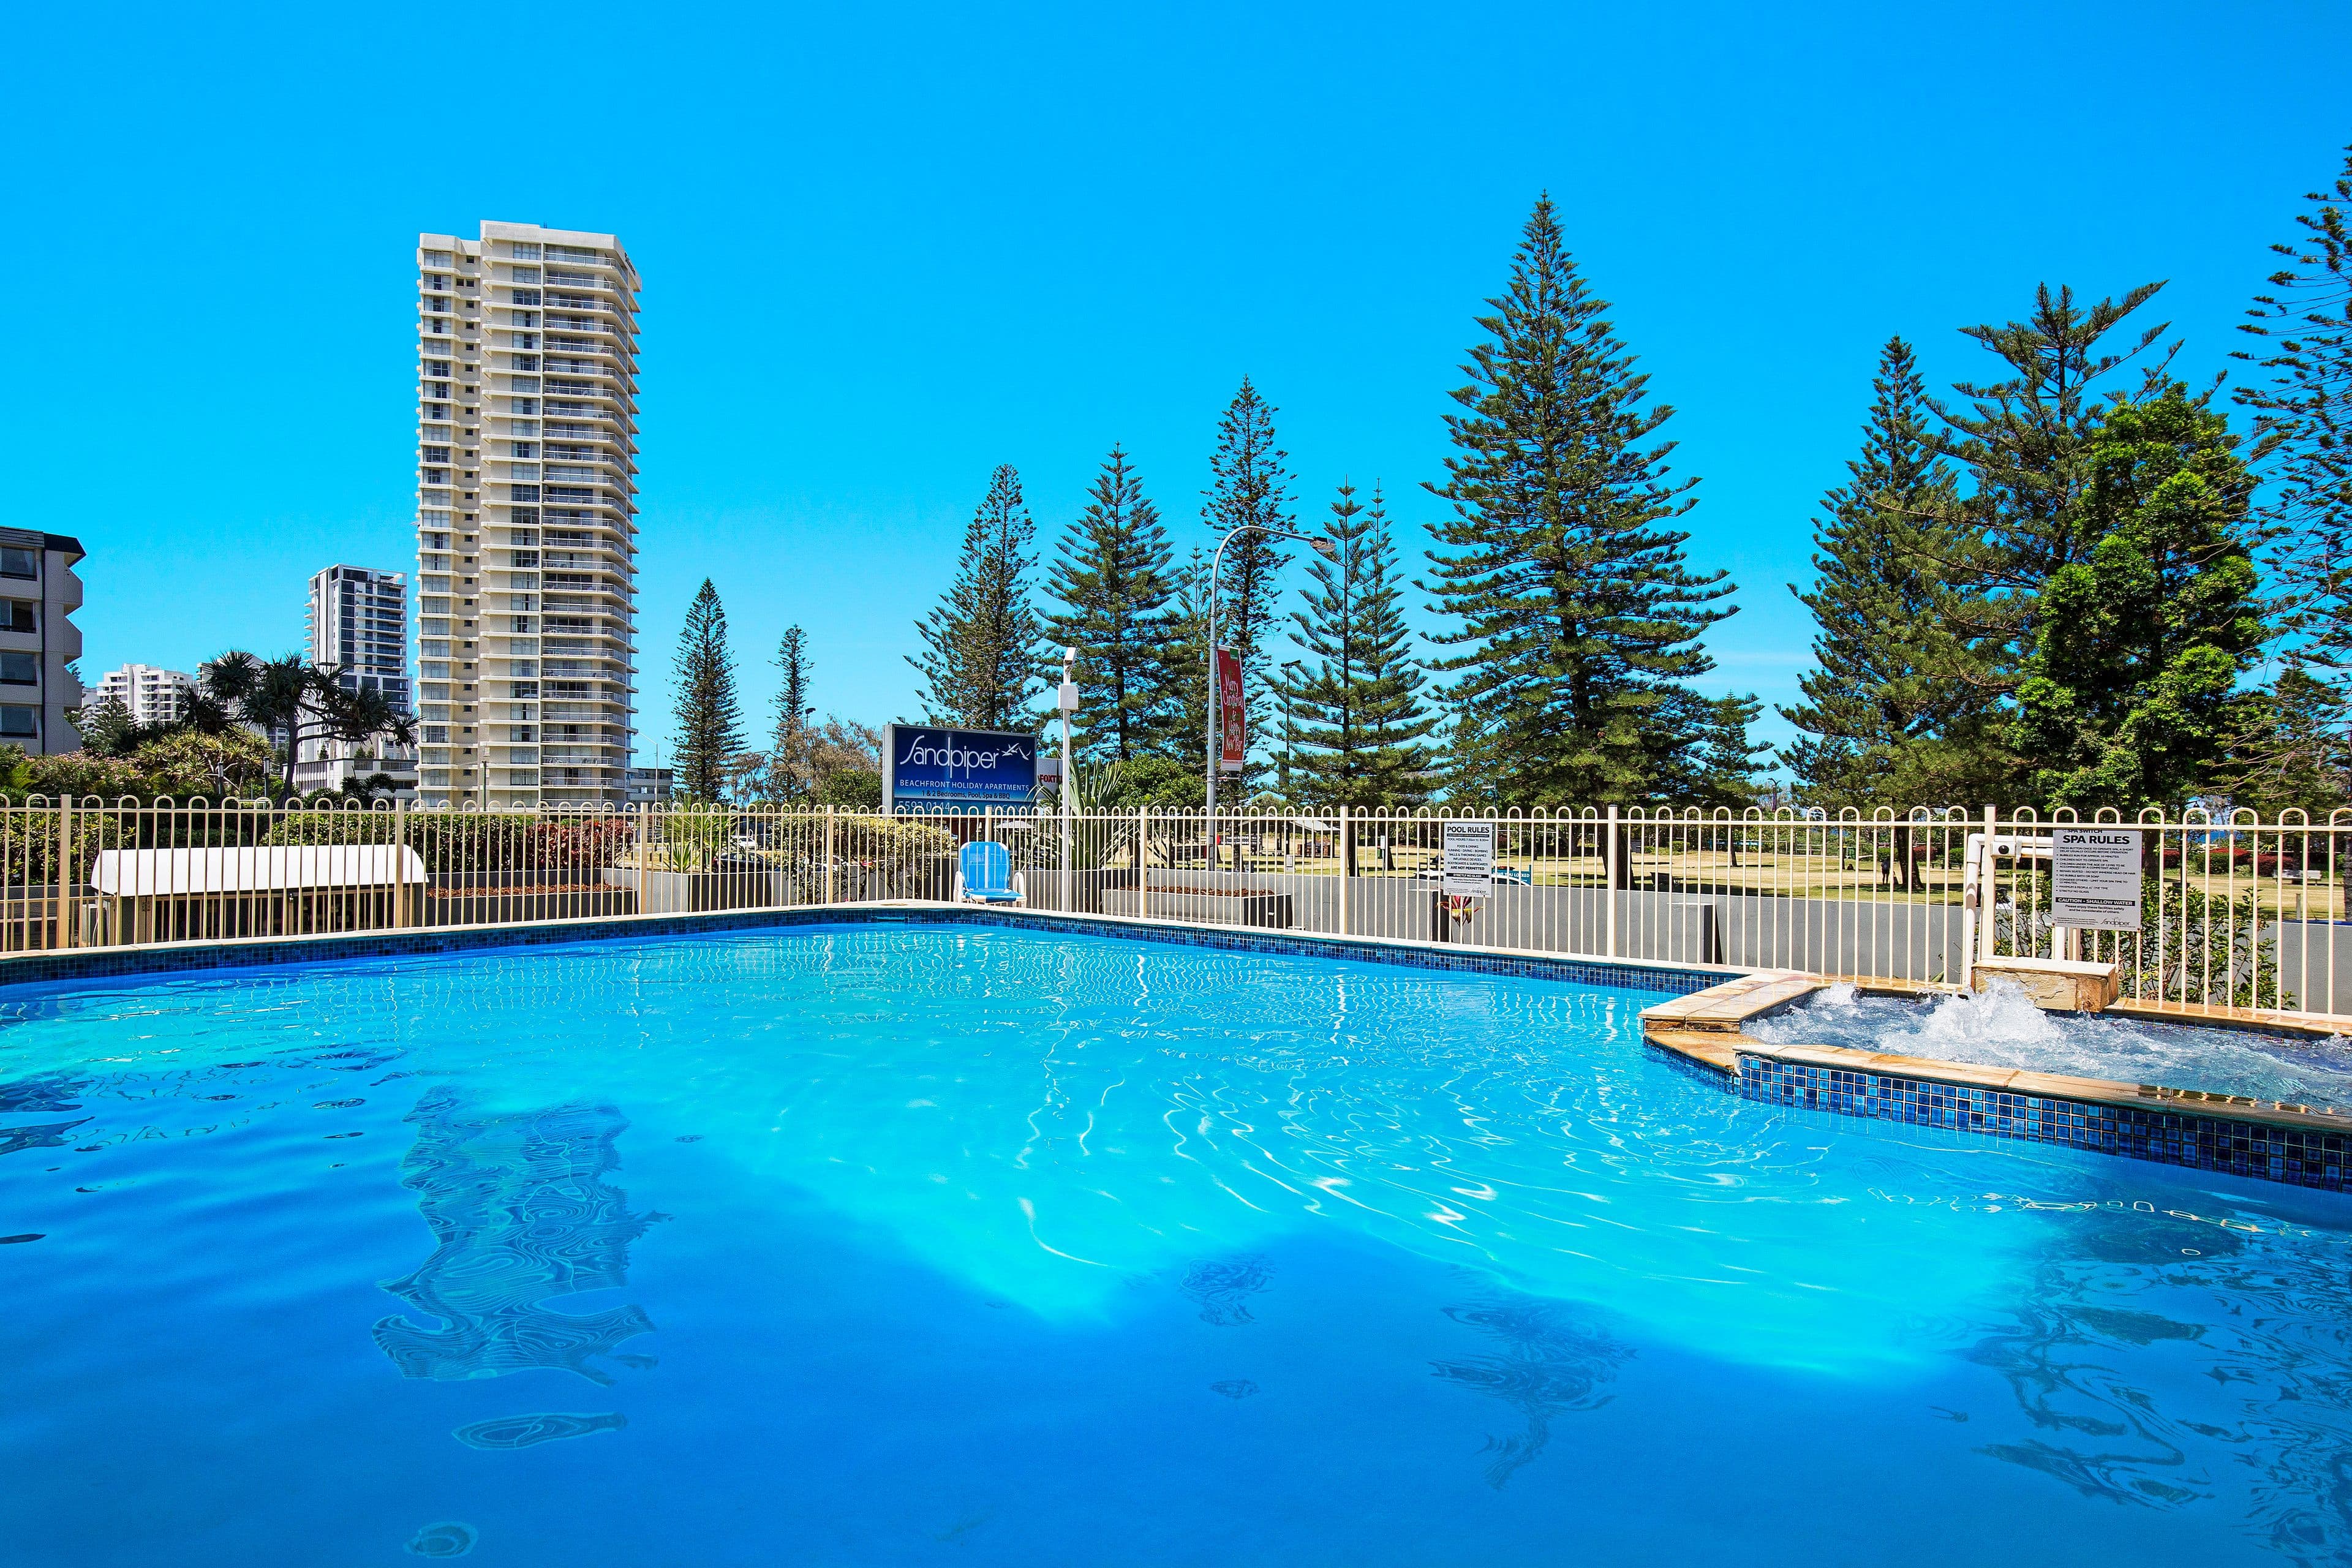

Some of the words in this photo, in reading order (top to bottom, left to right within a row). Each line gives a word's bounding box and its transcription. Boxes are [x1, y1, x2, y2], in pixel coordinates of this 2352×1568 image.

[1225, 674, 1238, 697] Merry
[1228, 720, 1241, 742] Happy
[900, 735, 999, 779] Sandpiper
[900, 779, 951, 788] BEACHFRONT
[1040, 774, 1063, 783] FOXT
[2089, 835, 2130, 844] RULES
